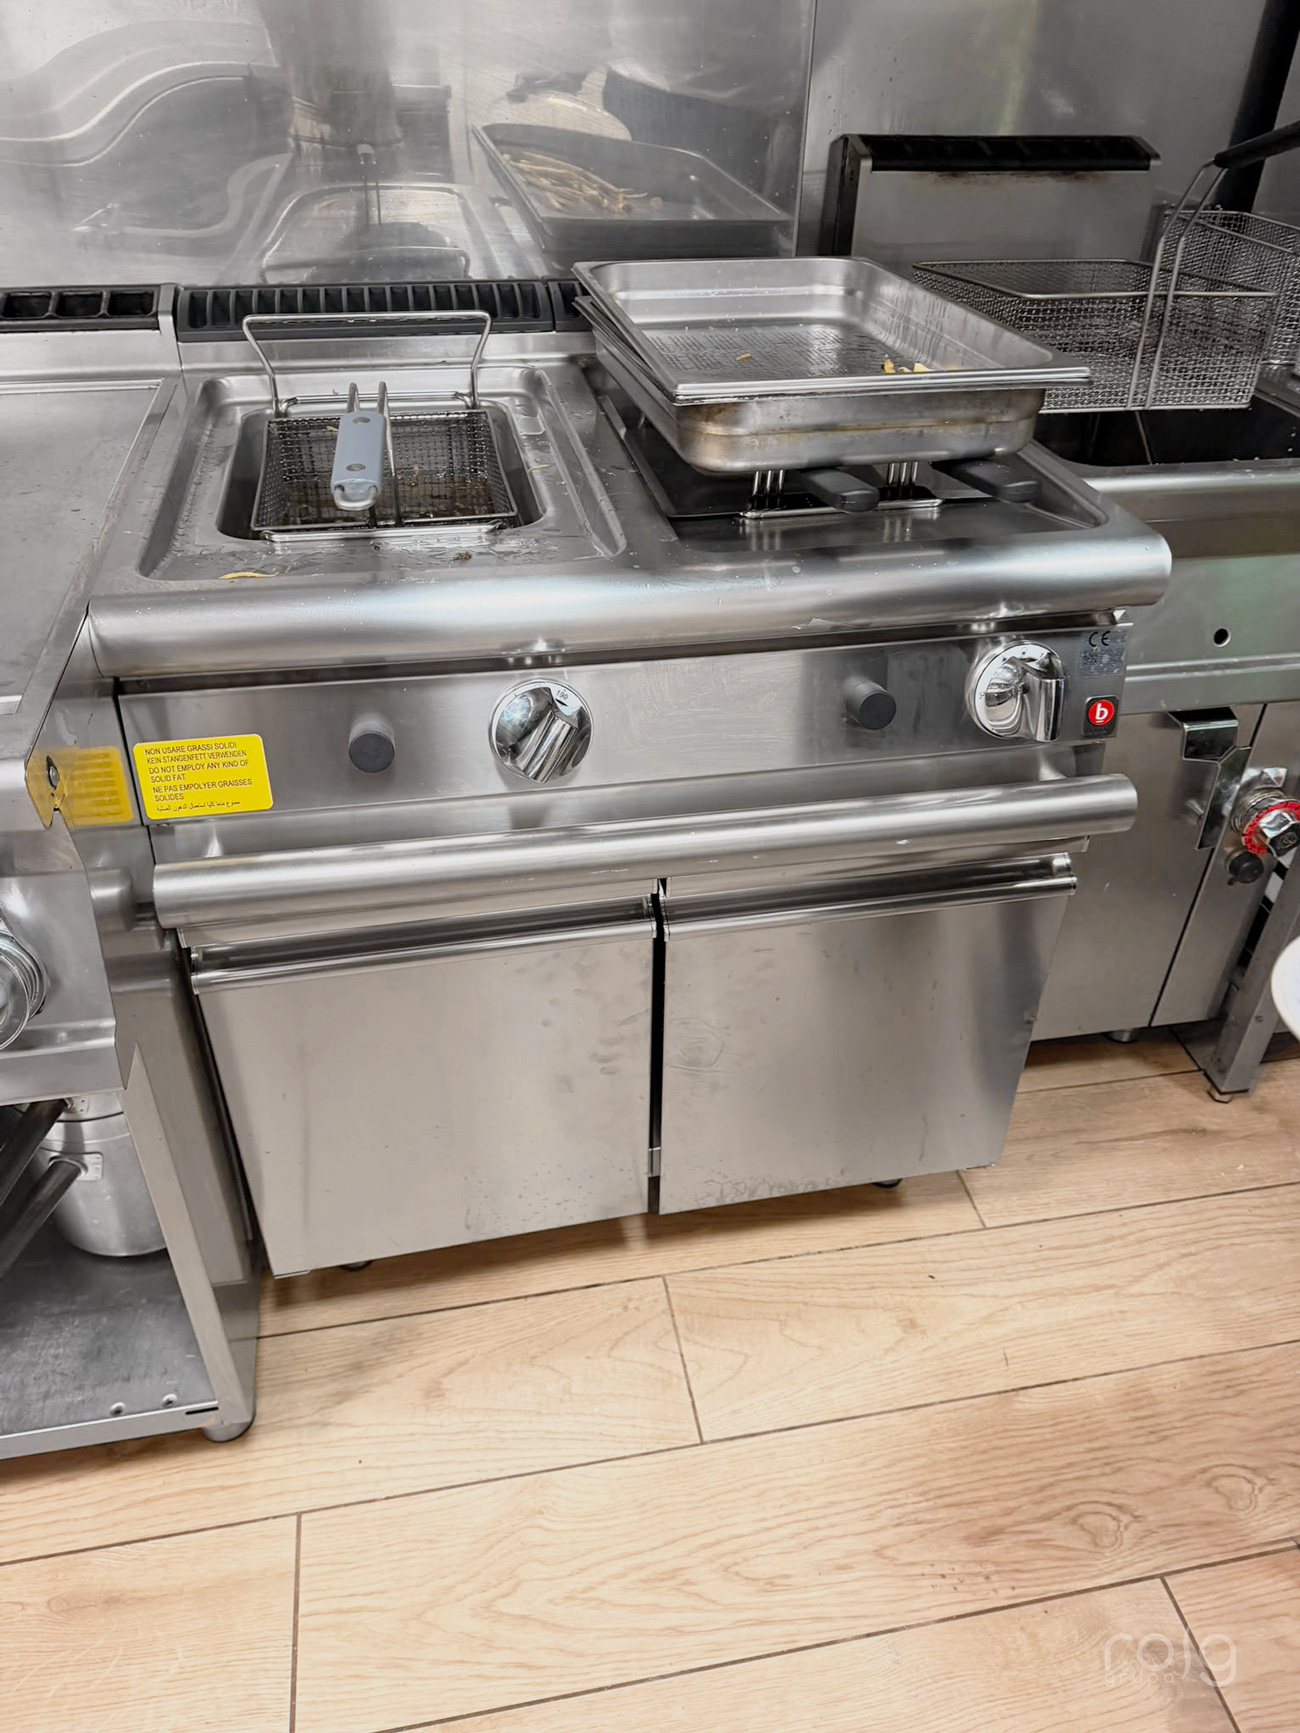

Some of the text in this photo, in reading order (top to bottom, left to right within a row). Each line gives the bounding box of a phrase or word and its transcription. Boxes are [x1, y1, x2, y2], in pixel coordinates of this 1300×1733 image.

[556, 689, 569, 701] 190
[145, 741, 237, 756] NON USARE GRASSI SOLIDI
[162, 753, 206, 763] STANGENFETT
[207, 750, 247, 759] VERWENDEN
[161, 765, 175, 773] NOT
[177, 763, 205, 772] EMPLOY
[222, 760, 238, 768] KIND
[150, 775, 171, 783] SOLID
[164, 784, 178, 792] PAS
[218, 779, 252, 788] GRAISSES
[154, 793, 184, 802] SOLIDES
